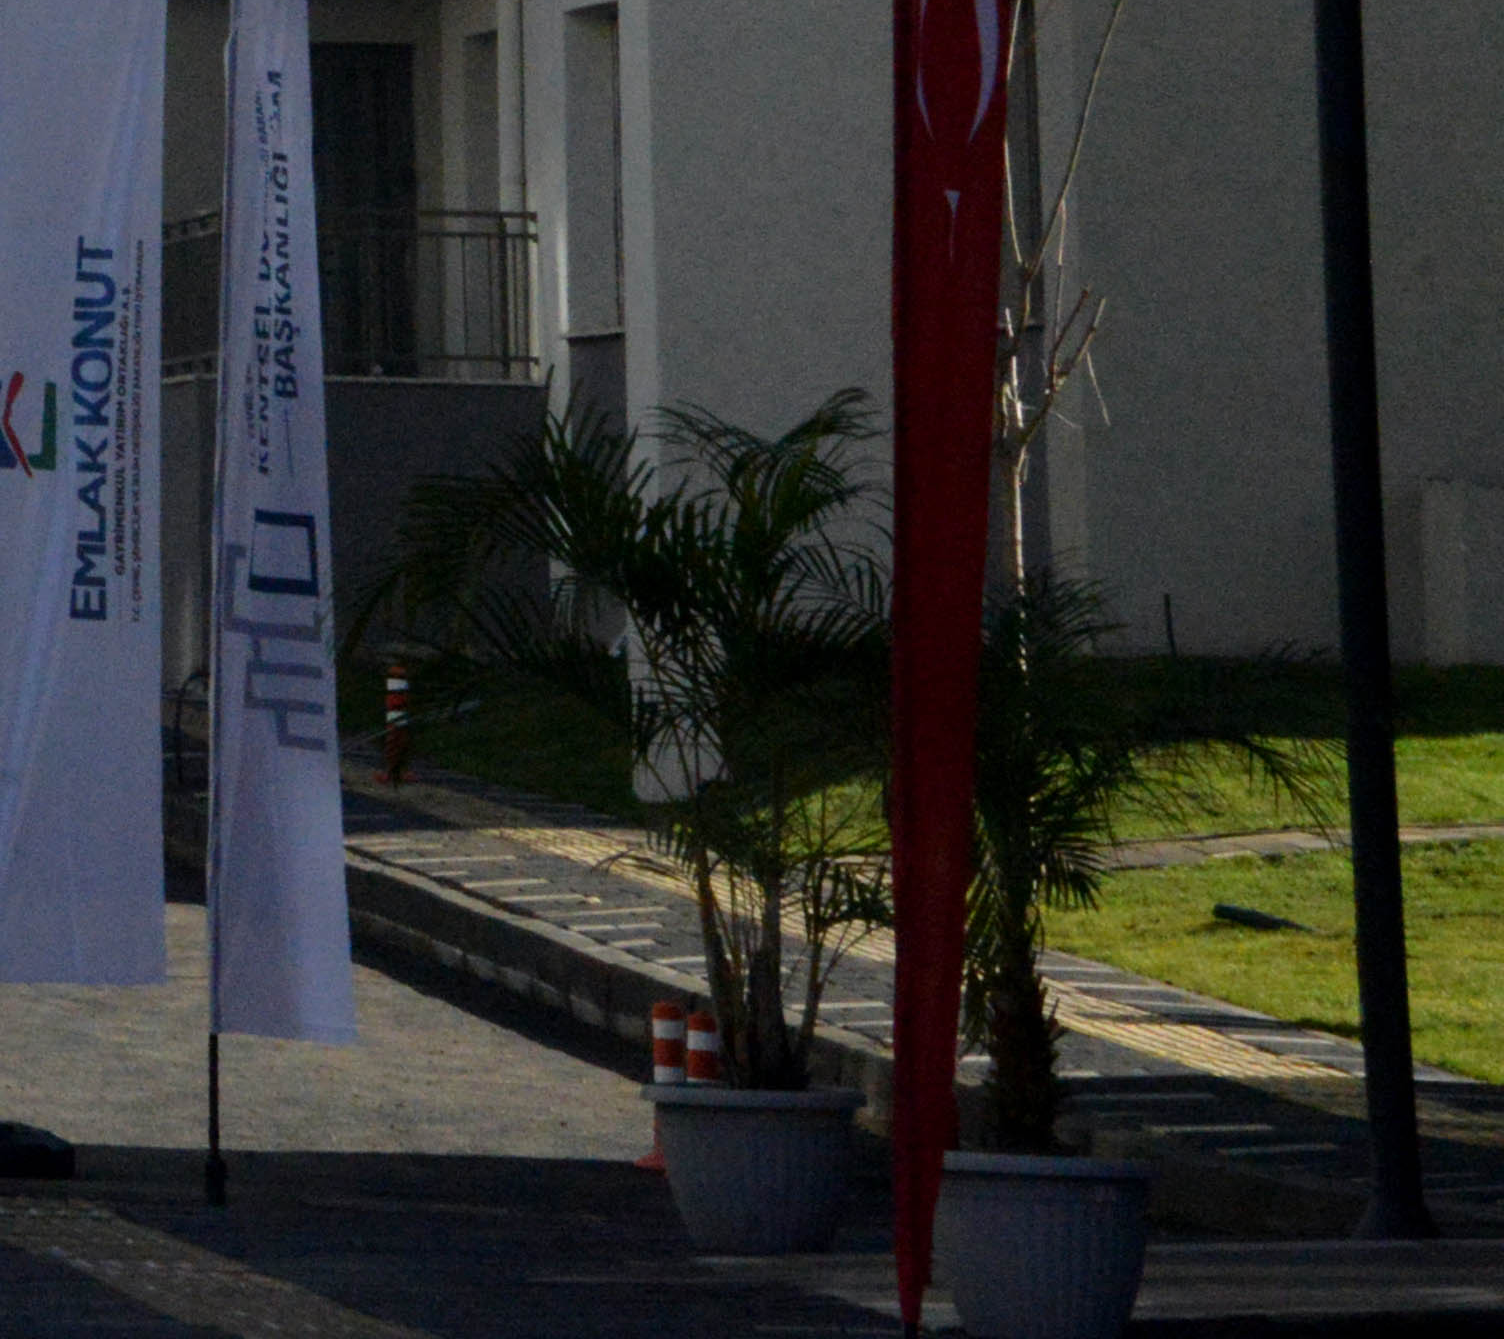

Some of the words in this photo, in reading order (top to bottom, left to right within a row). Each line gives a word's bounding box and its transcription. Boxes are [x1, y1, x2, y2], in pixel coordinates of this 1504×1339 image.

[70, 235, 115, 427] KONUT
[270, 152, 300, 399] BAŞKANLIĞI
[69, 437, 107, 622] EMLAK
